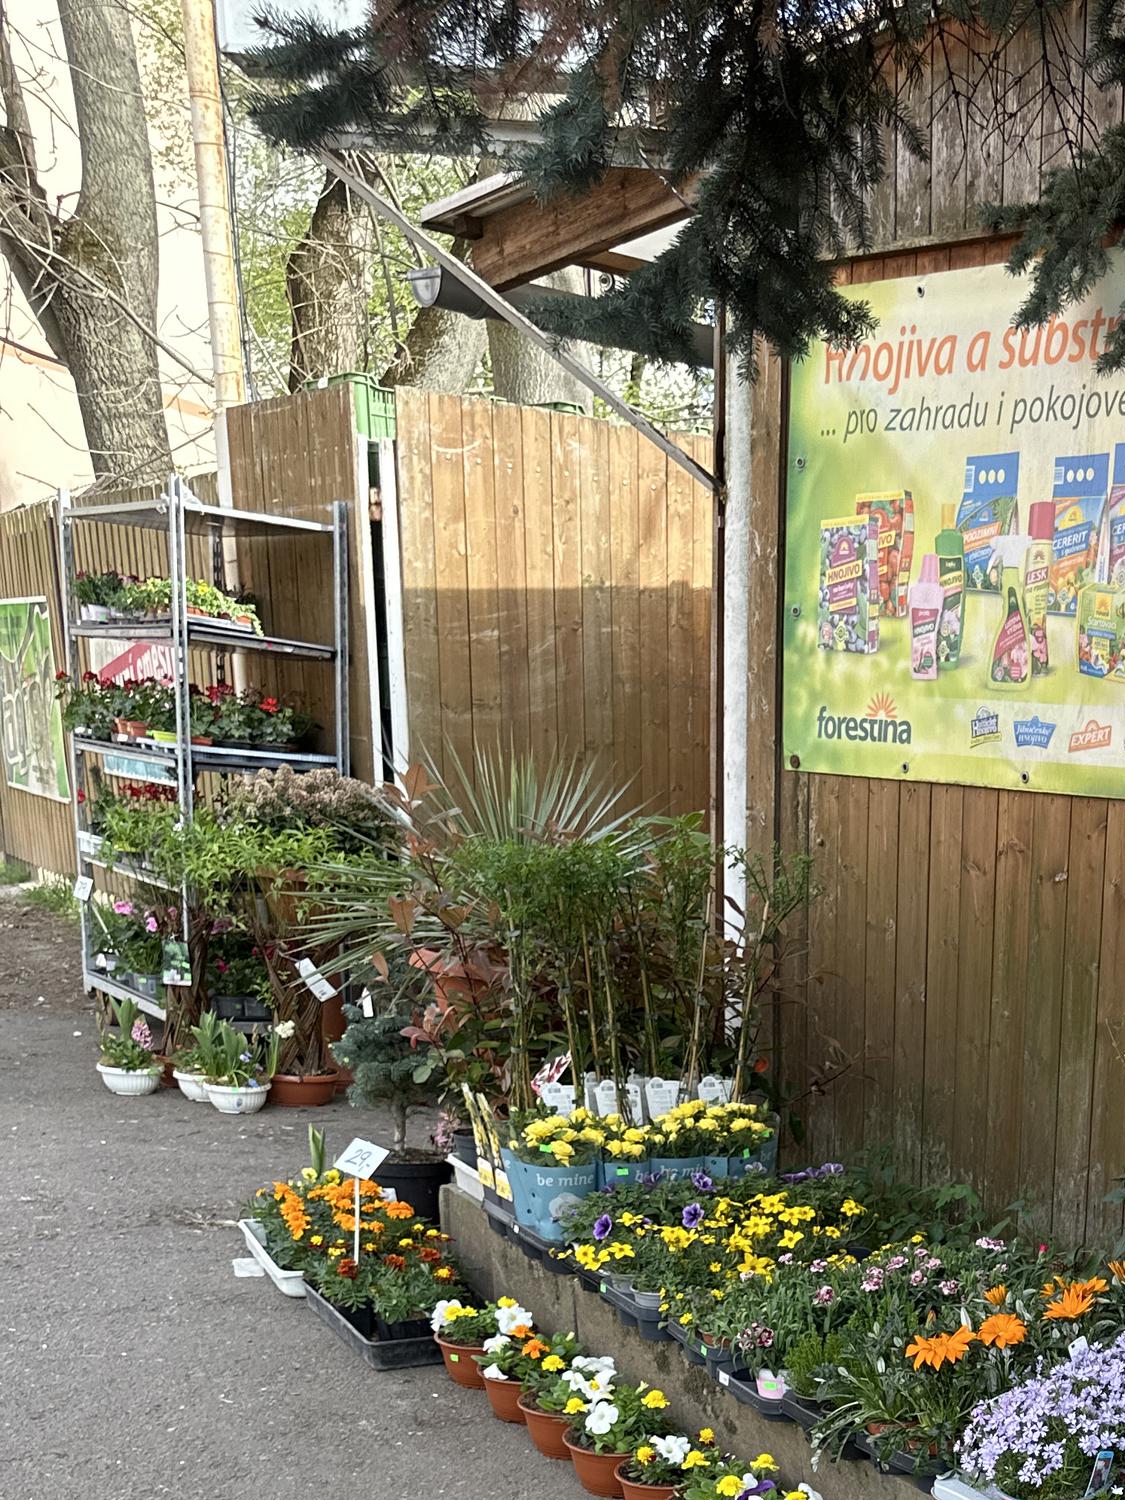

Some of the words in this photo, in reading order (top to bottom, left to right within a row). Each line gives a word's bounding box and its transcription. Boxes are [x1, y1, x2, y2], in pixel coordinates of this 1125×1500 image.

[966, 330, 992, 374] a
[843, 407, 878, 443] pro
[884, 391, 989, 431] zahradu
[996, 390, 1005, 426] i
[817, 705, 912, 745] forestina
[1071, 728, 1110, 745] EXPERT
[536, 1172, 554, 1187] be
[558, 1173, 594, 1187] mine
